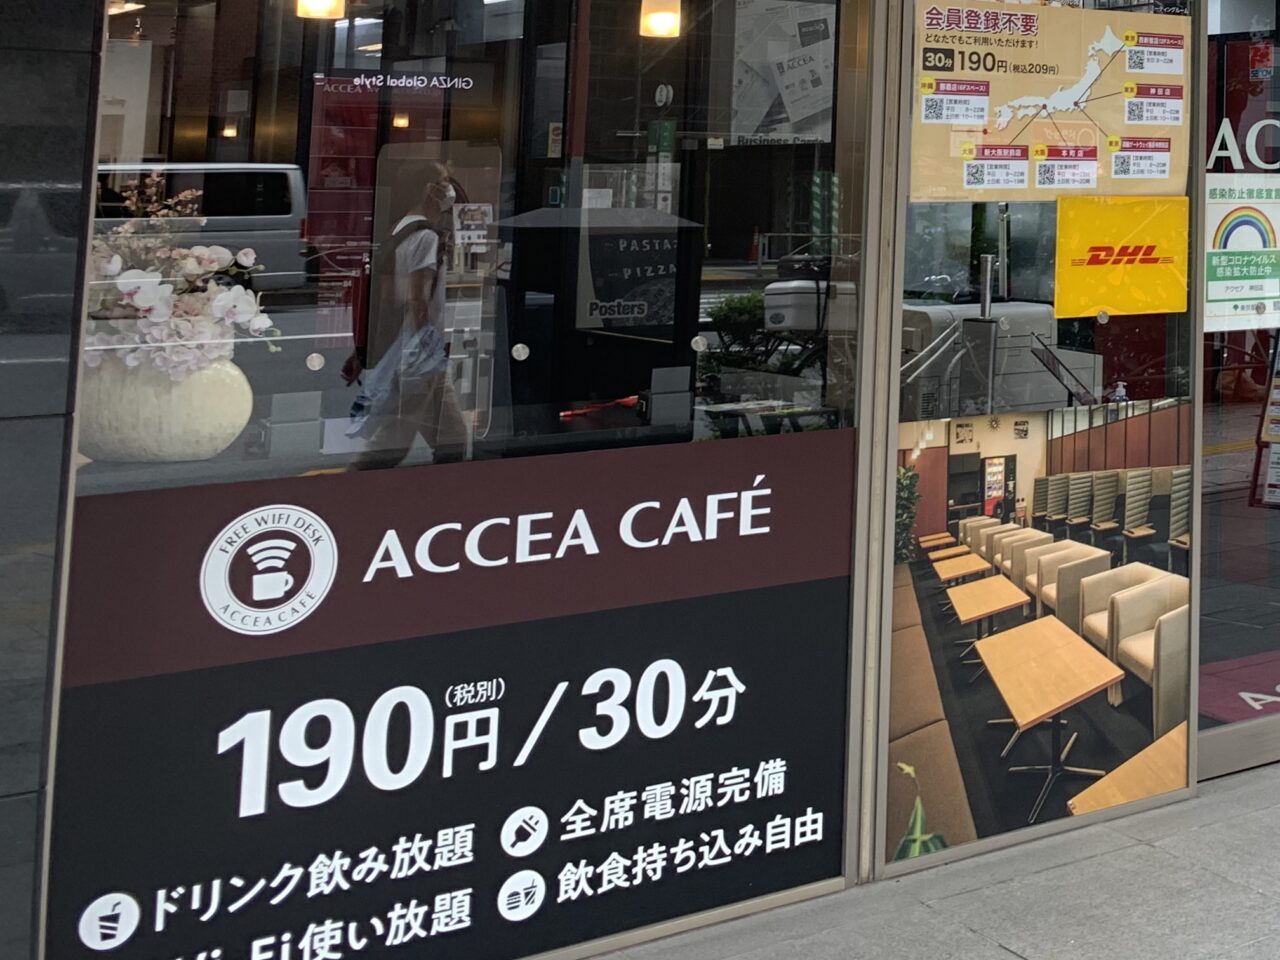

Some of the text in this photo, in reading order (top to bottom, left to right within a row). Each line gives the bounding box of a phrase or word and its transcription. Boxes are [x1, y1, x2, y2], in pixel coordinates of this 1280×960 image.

[925, 6, 1038, 35] 会員登録不要
[925, 52, 953, 67] 30分
[1086, 245, 1161, 266] DHL
[1212, 253, 1276, 266] 新型コロナウイルス
[1216, 267, 1273, 278] 感染拡大防止中
[589, 300, 646, 317] Posters
[219, 513, 325, 554] FREE WIFI DESK
[361, 474, 773, 583] ACCEA CAFÉ
[220, 604, 272, 627] ACCEA
[577, 658, 747, 751] 30分
[558, 758, 788, 842] 全席電源完備
[556, 807, 825, 905] 飲食持ち込み自由
[153, 824, 476, 932] ドリンク飲み放題
